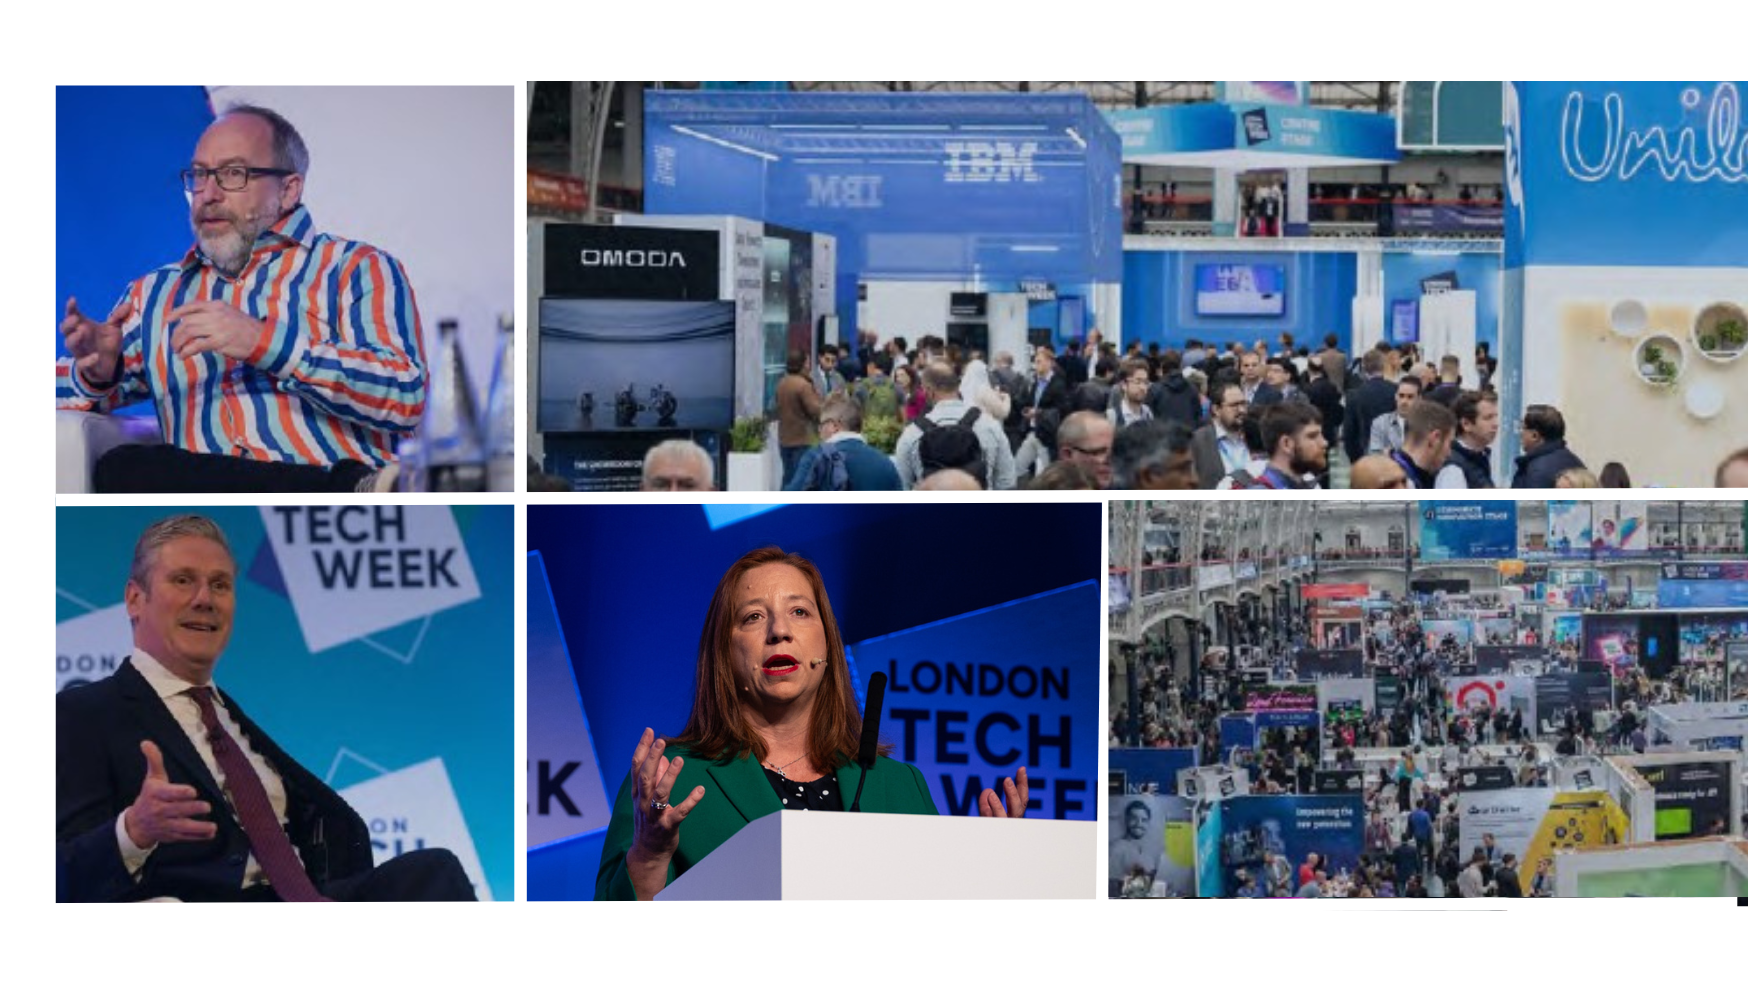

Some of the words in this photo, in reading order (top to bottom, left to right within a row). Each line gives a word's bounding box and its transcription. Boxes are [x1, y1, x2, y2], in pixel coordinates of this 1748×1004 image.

[1561, 82, 1748, 182] Unil
[944, 142, 1039, 182] IBM
[273, 505, 406, 545] TECH
[312, 548, 460, 590] WEEK
[889, 659, 1070, 700] LONDON
[889, 707, 1072, 770] TECH
